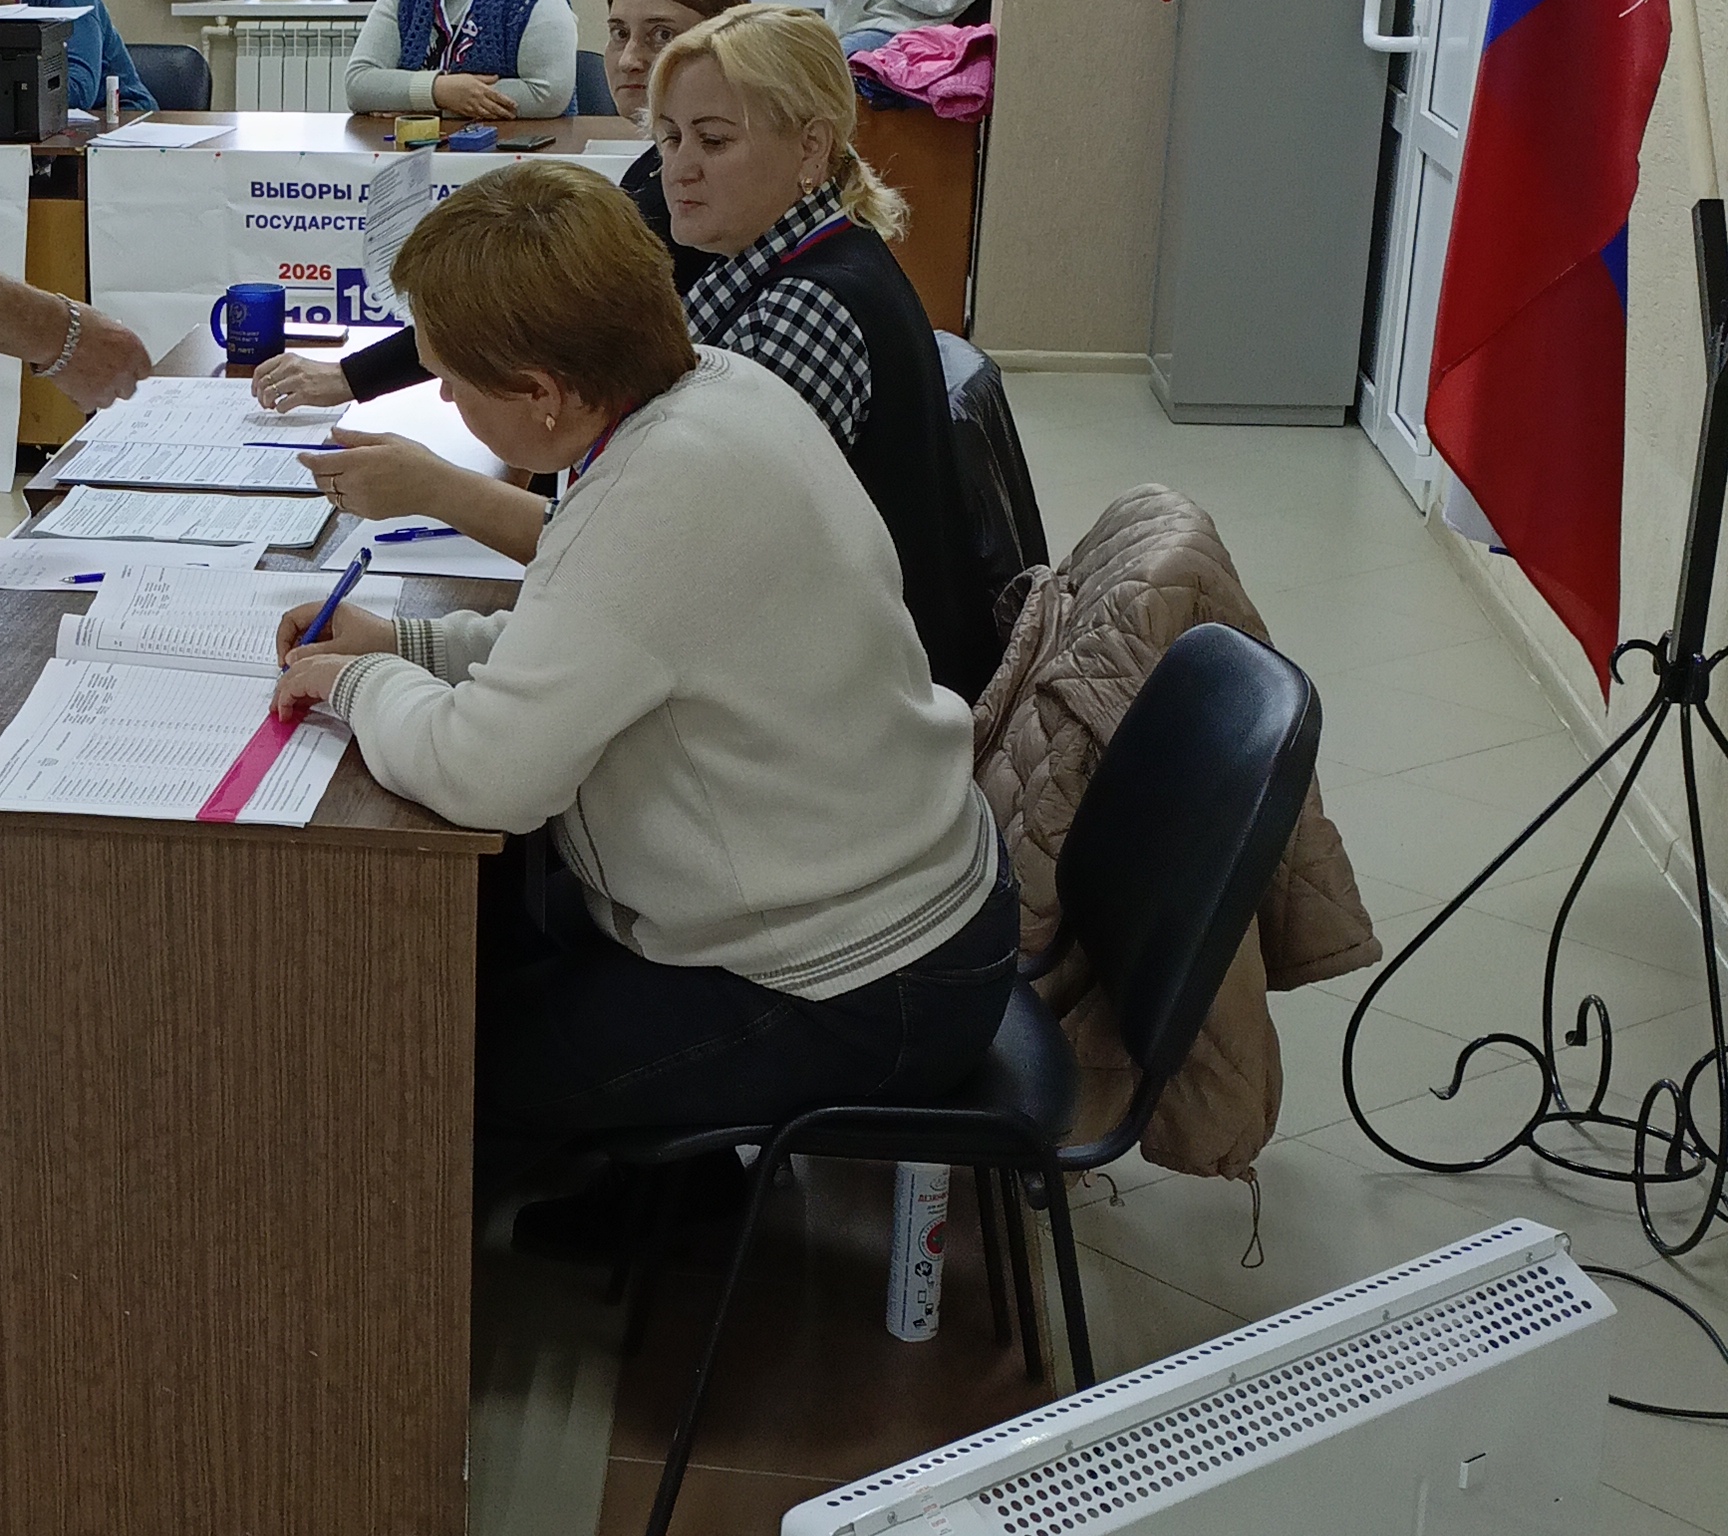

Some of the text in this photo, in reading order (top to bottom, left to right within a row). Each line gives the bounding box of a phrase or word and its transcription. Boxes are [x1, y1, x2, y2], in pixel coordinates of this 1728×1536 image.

[250, 181, 352, 201] ВЫБОРЫ
[278, 263, 332, 281] 2026
[343, 284, 391, 321] 19
